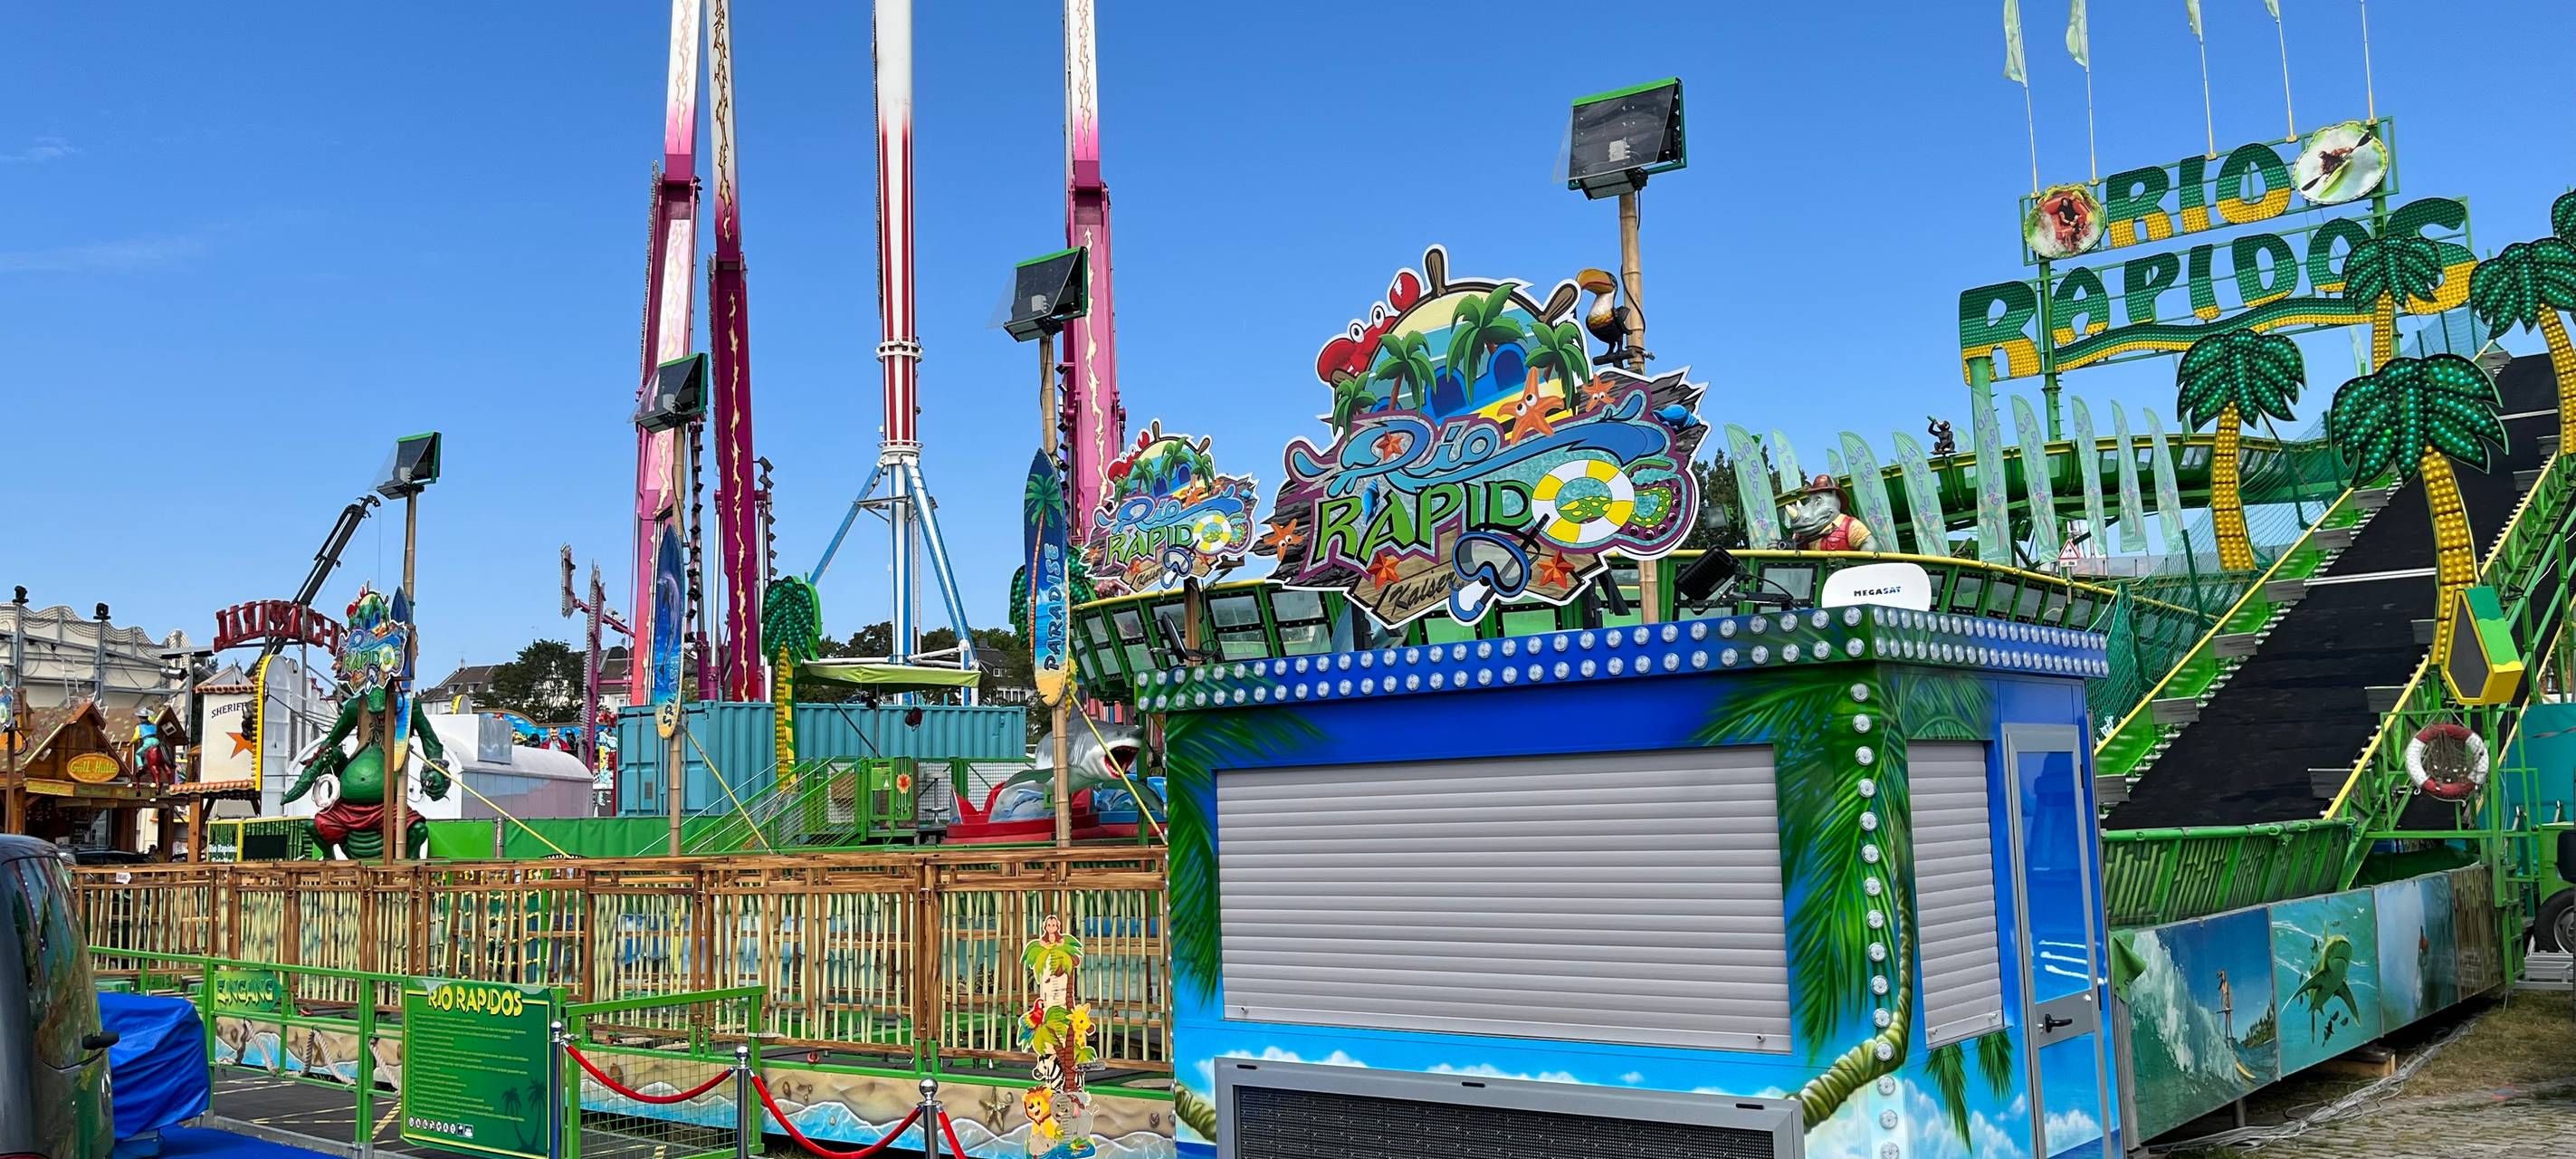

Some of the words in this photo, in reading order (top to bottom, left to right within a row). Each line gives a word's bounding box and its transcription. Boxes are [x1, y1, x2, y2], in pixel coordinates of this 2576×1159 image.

[2105, 143, 2291, 250] RIO
[1959, 197, 2479, 387] RAPIDOS
[1044, 542, 1064, 672] PARADISE
[1388, 570, 1456, 617] Kaiser
[1854, 586, 1901, 597] MEGASAT
[427, 984, 453, 1011] RIO
[456, 985, 524, 1018] RAPIDOS
